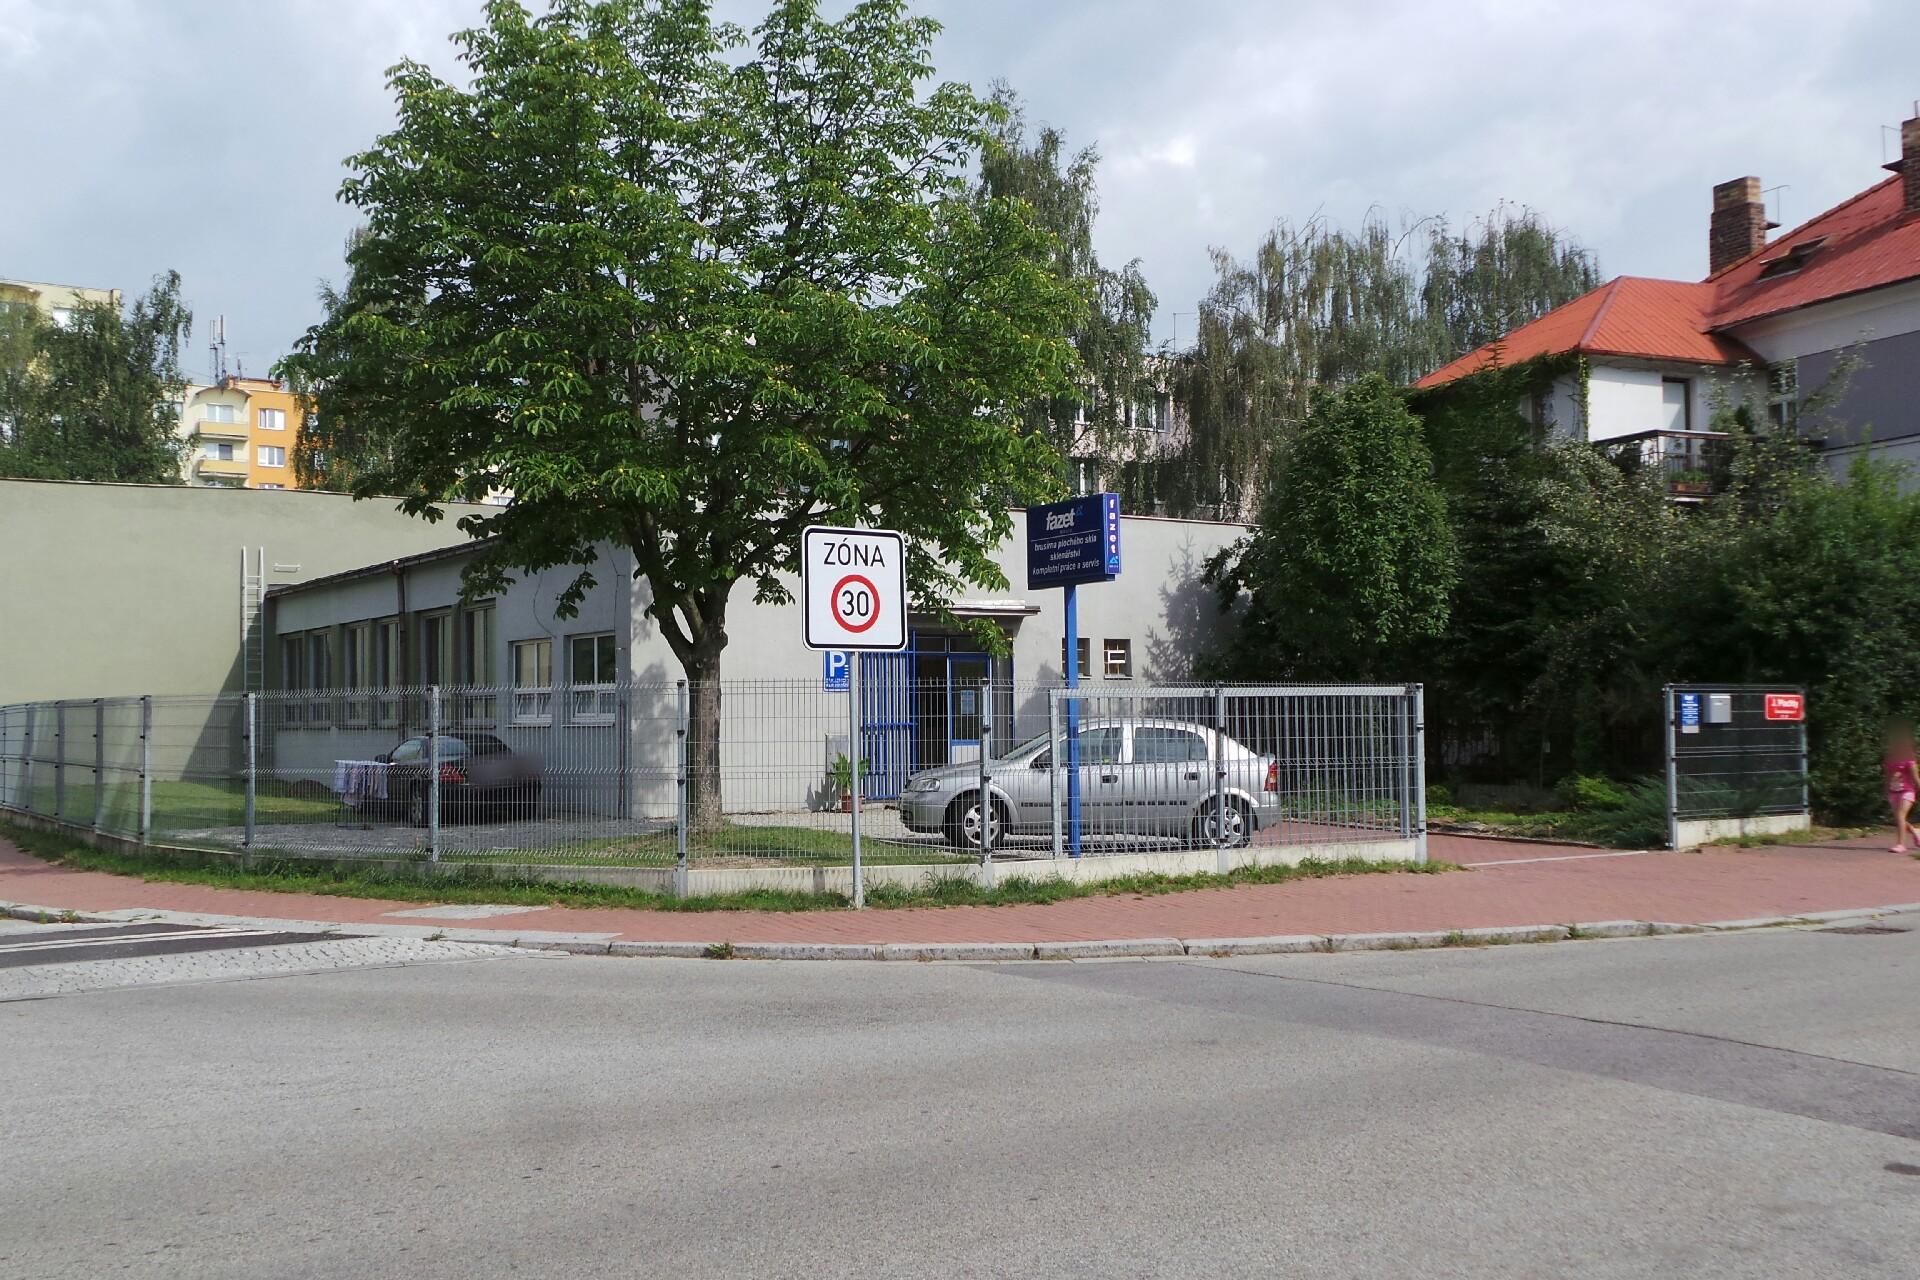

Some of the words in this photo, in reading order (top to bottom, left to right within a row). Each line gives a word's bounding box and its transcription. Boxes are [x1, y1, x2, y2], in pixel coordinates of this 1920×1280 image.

[1046, 508, 1075, 531] fazet
[1085, 534, 1097, 543] skla
[823, 537, 886, 568] ZÓNA
[1060, 562, 1076, 573] práce
[1082, 559, 1100, 569] servis
[841, 589, 869, 617] 30
[829, 650, 847, 678] P
